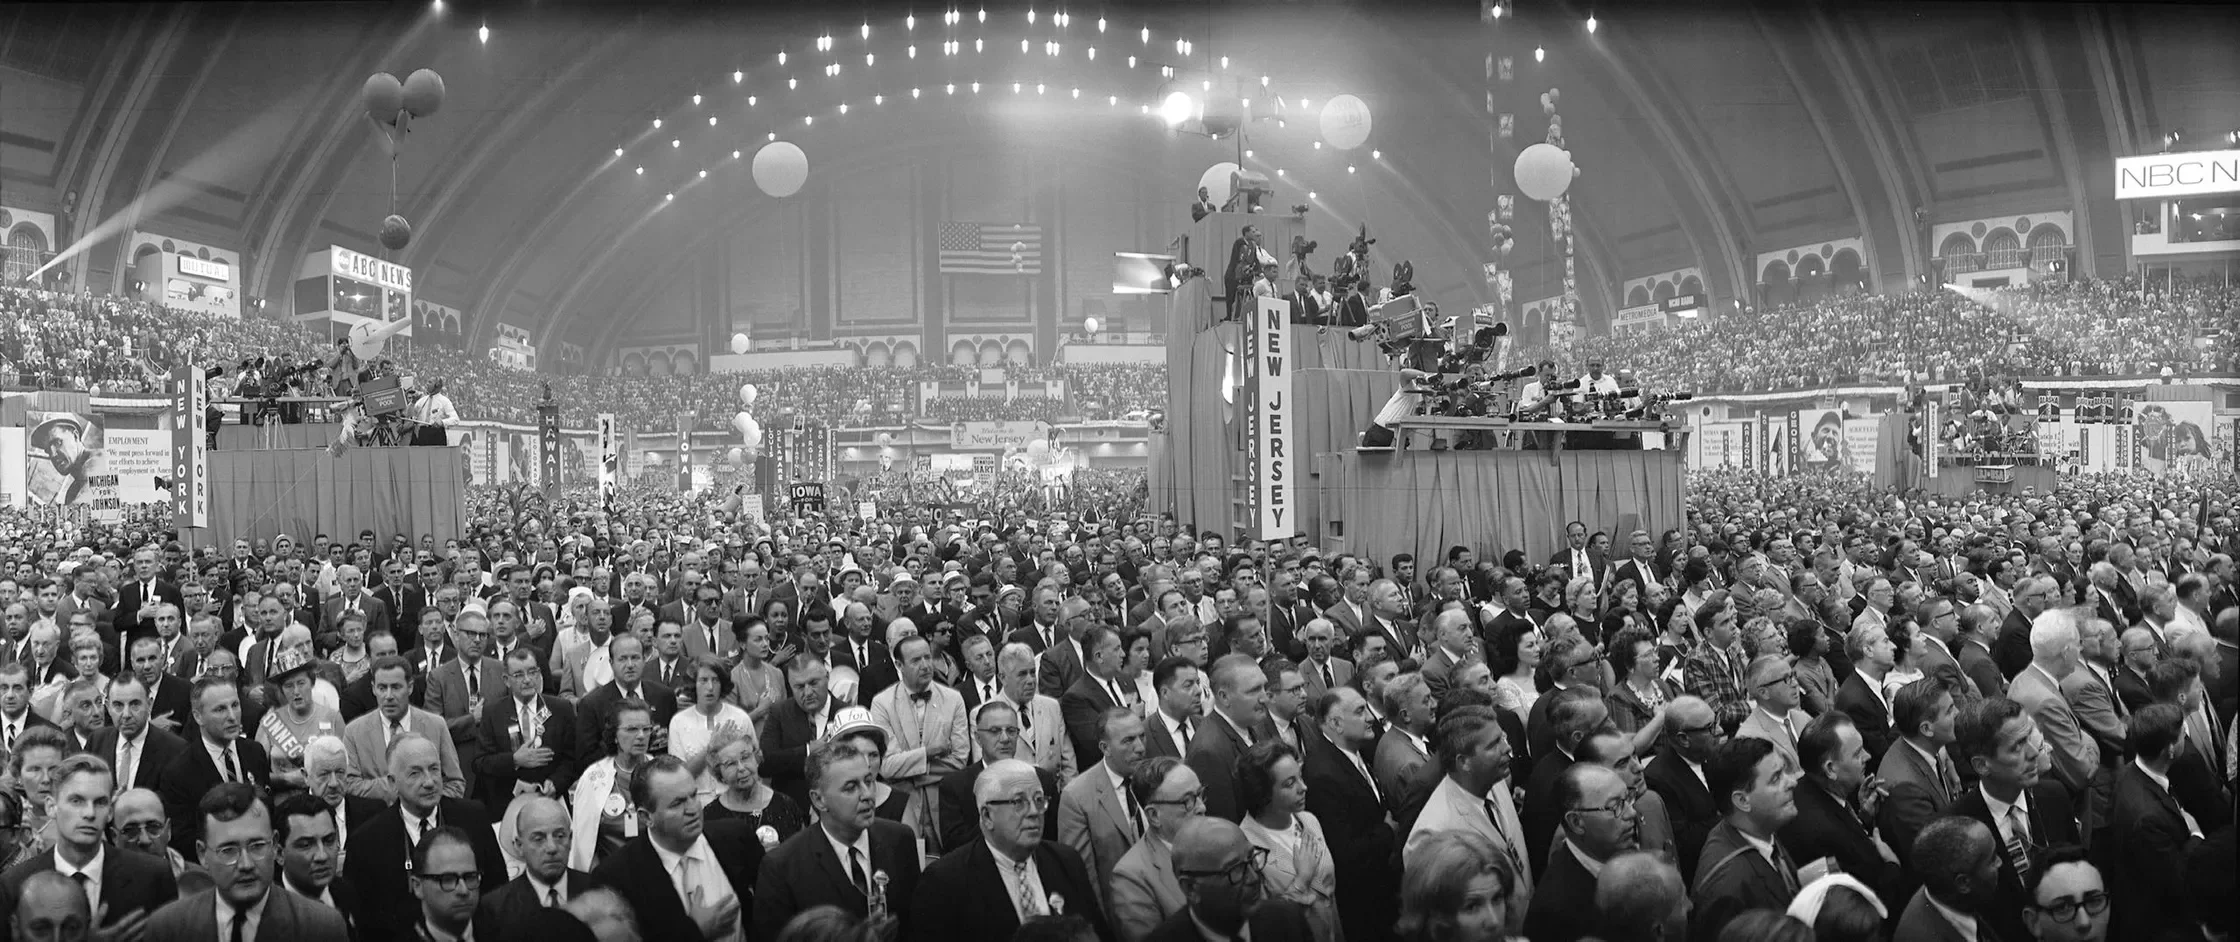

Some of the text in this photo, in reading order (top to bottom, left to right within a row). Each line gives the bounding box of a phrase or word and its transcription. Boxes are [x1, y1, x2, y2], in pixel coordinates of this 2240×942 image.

[2122, 162, 2204, 189] NBC
[183, 260, 227, 278] MUTUAL
[353, 255, 376, 278] ABC
[381, 263, 412, 288] NEWS
[1620, 308, 1658, 321] METROMEDIA
[1246, 310, 1256, 528] NEW JERSEY
[1266, 308, 1284, 528] NEW JERSEY
[108, 437, 149, 445] EMPLOYMENT
[176, 379, 188, 515] NEW YORK
[195, 379, 204, 515] NEW YORK
[971, 434, 1025, 446] New Jersey
[1743, 424, 1751, 466] ARIZONA
[1790, 411, 1798, 471] GEORGIA
[545, 415, 556, 488] HAWAI
[680, 431, 689, 474] IOWA
[119, 467, 149, 476] employment
[974, 465, 994, 473] HART
[88, 474, 119, 487] MICHIGAN
[792, 485, 822, 498] IOWA
[91, 498, 120, 511] JOHNSON
[848, 710, 863, 721] for
